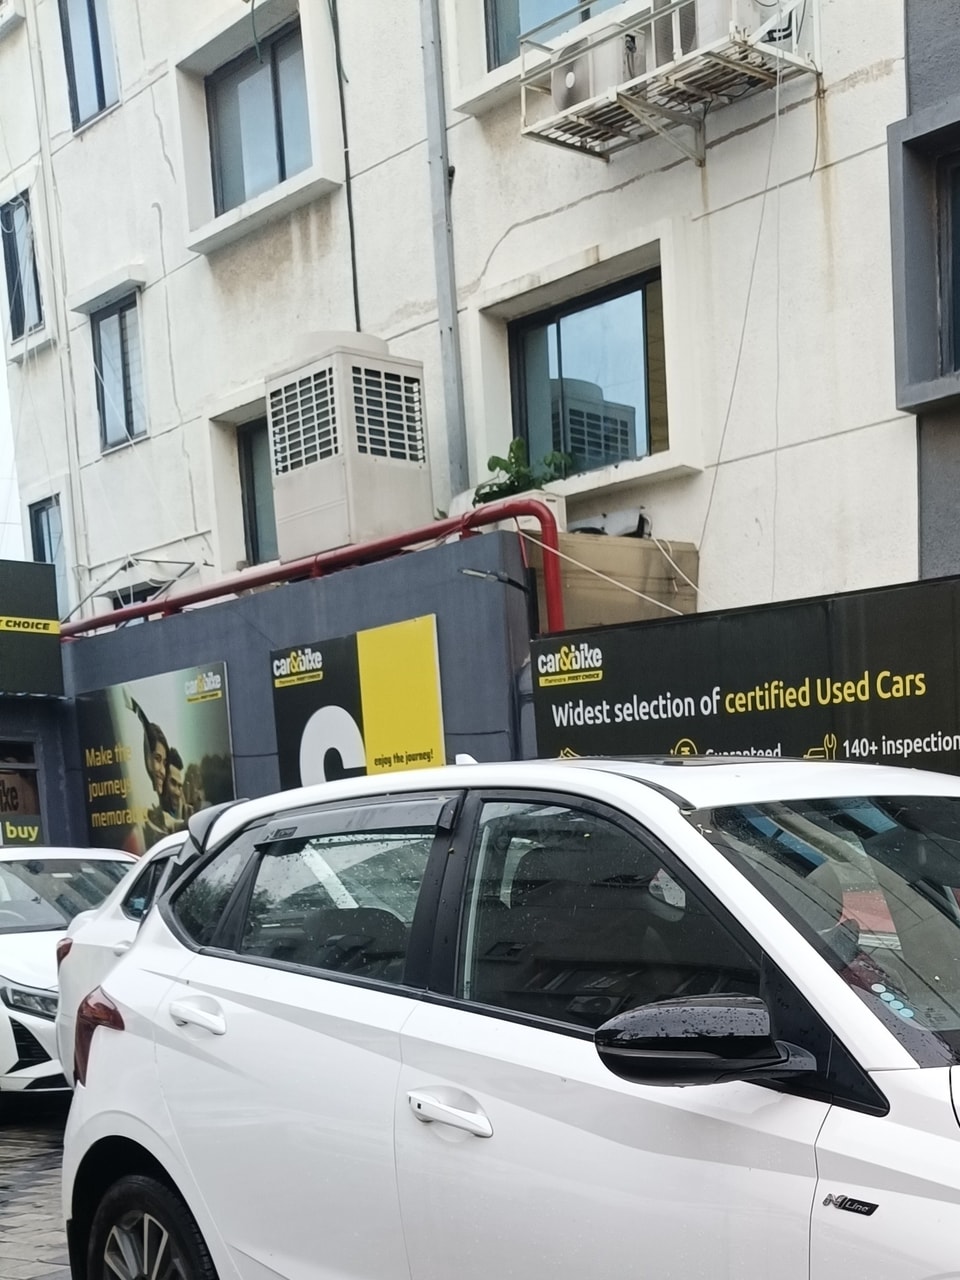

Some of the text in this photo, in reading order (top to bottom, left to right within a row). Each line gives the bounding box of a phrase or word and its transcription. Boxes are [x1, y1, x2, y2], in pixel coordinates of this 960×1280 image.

[5, 619, 51, 631] CHOICE
[272, 648, 323, 677] car&bike
[537, 642, 603, 674] car&bike
[551, 670, 927, 728] Widest selection of certified Used Cars
[85, 745, 113, 768] Make
[374, 748, 434, 768] enjoy the journey!
[842, 737, 879, 758] 140+
[5, 821, 39, 842] buy
